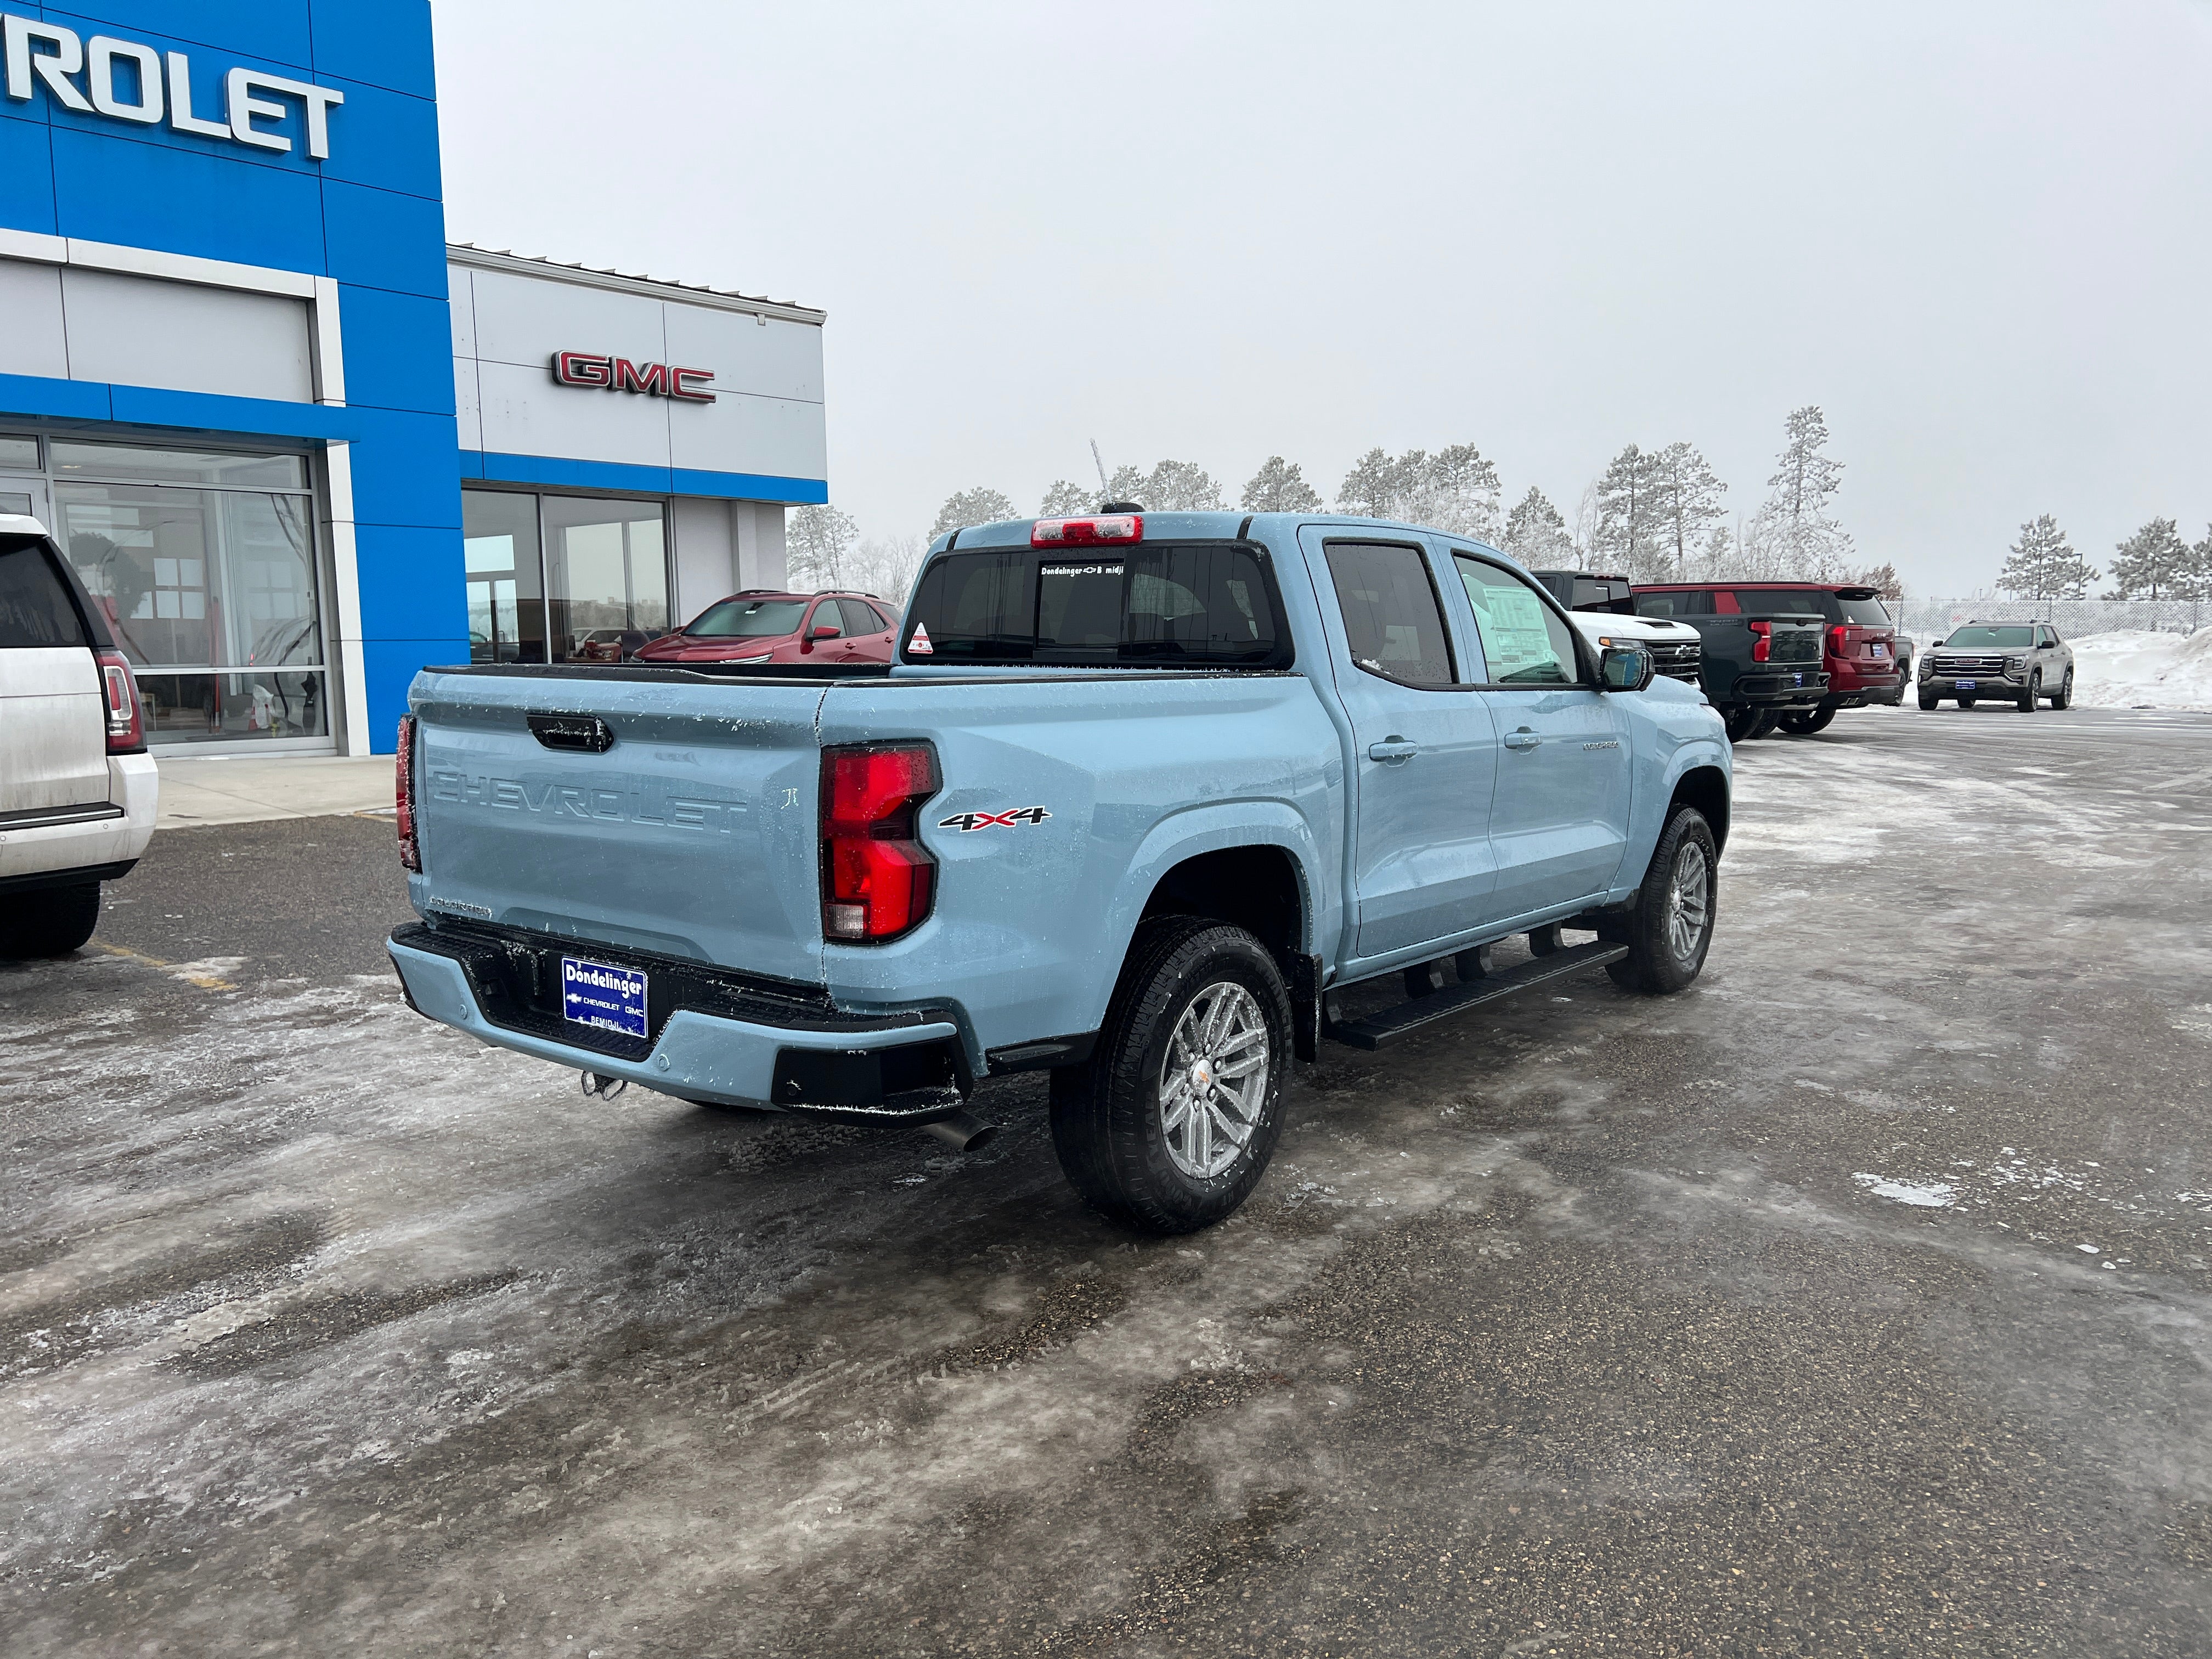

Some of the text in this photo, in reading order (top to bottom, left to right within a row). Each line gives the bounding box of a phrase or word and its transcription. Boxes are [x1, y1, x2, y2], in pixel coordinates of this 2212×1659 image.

[0, 13, 344, 160] ROLET
[551, 350, 716, 403] GMC
[1041, 567, 1083, 577] Dondelinger
[433, 771, 748, 834] CHEVROLET
[566, 964, 642, 999] Dondelinger
[583, 997, 644, 1017] CHEVROLET GMC
[591, 1015, 619, 1029] BEMIDJI
